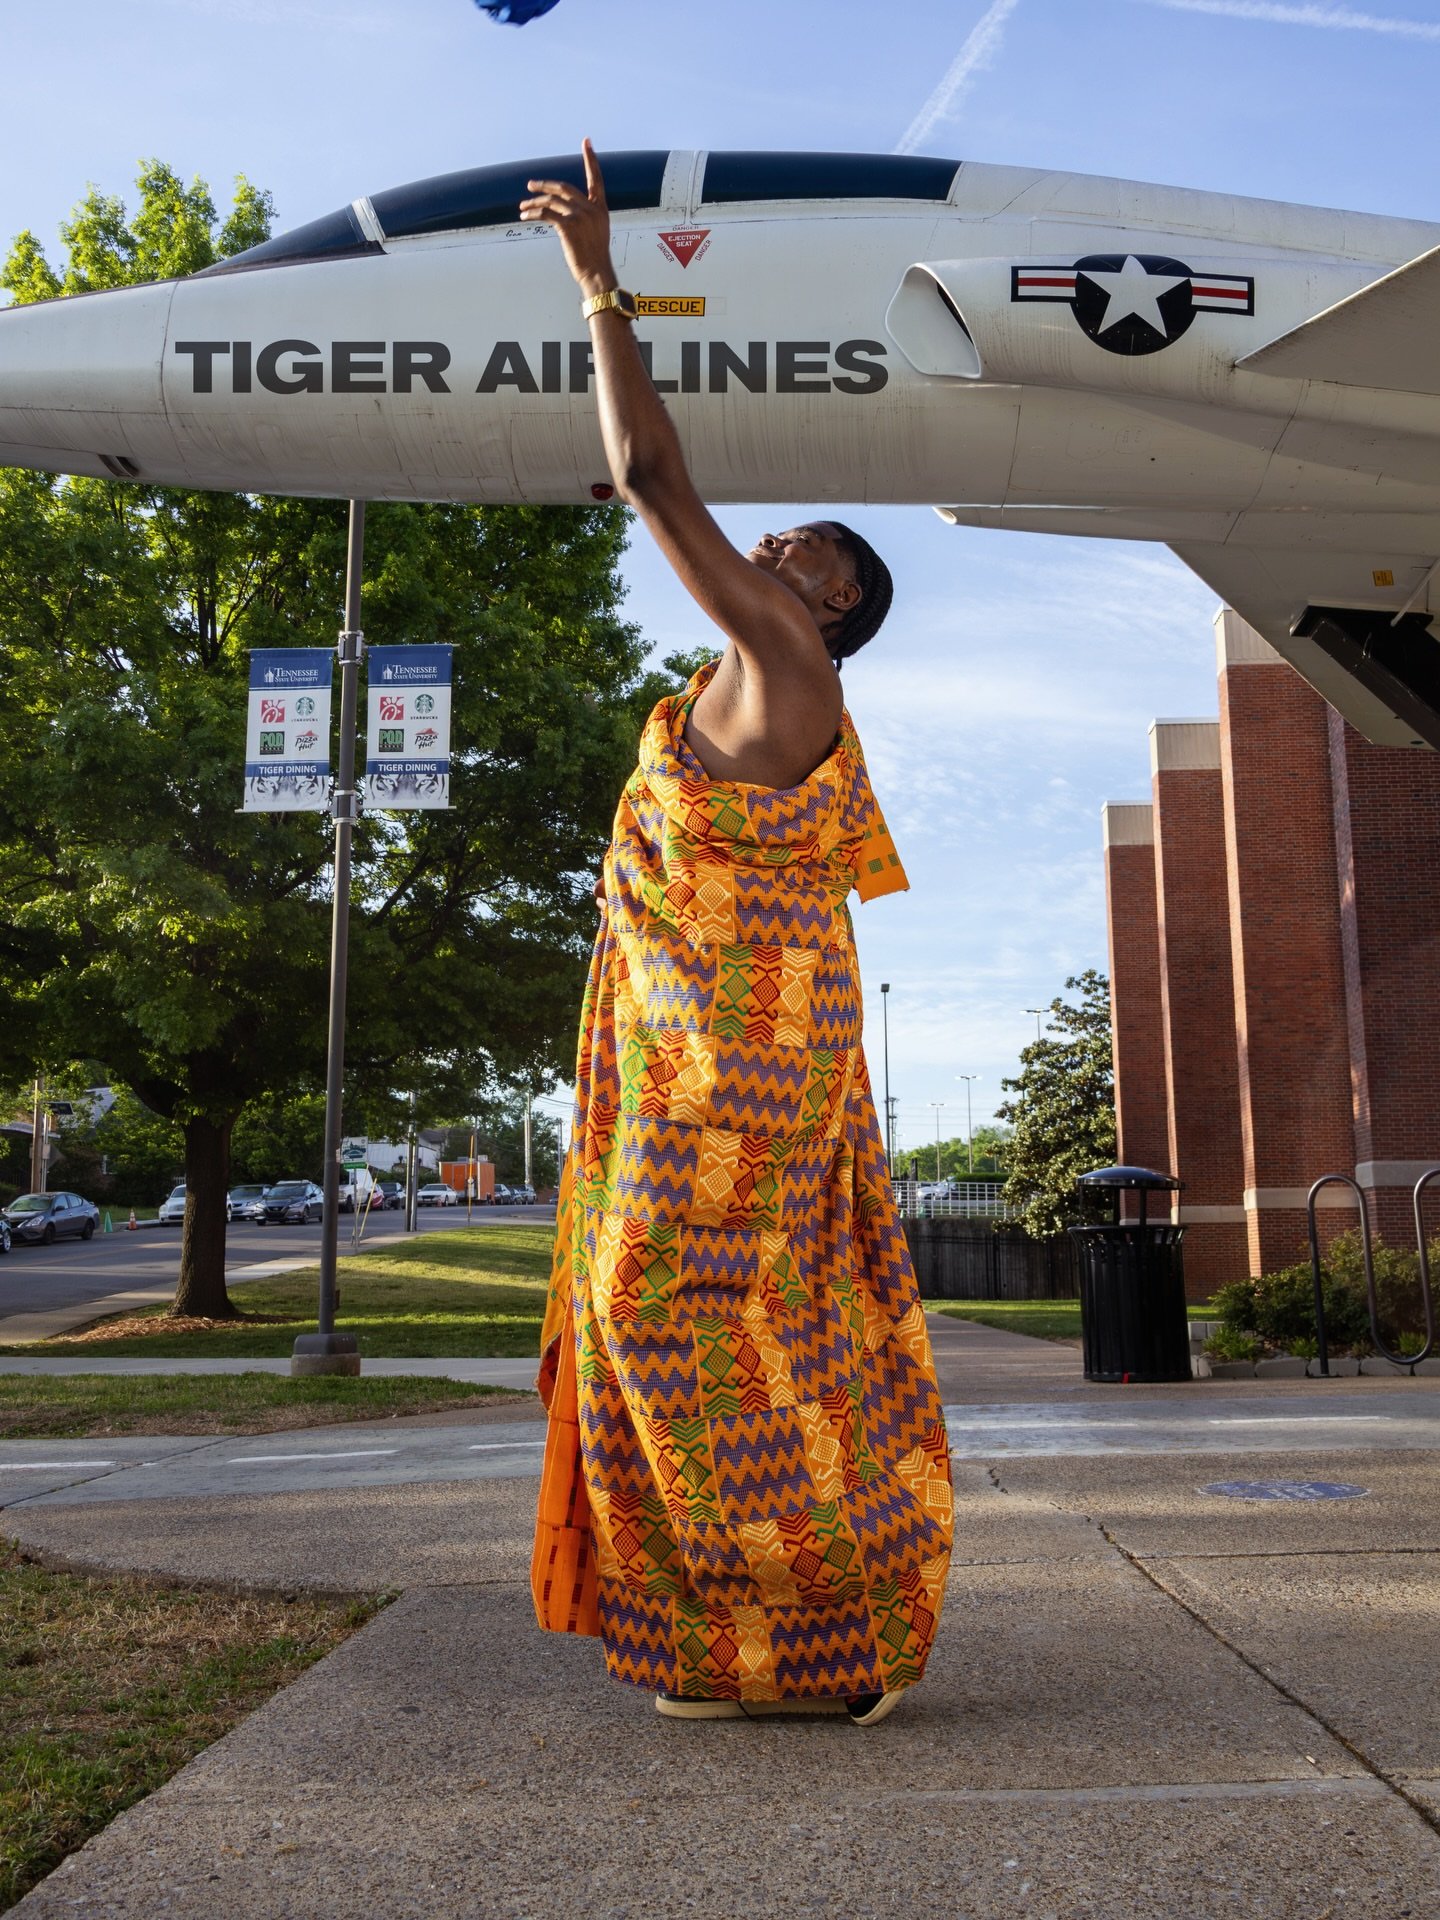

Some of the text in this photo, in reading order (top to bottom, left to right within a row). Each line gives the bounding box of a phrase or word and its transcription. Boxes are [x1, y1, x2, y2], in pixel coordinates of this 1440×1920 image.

[657, 242, 675, 263] DANGER
[695, 240, 711, 261] DANGER
[637, 301, 701, 313] RESCUE
[175, 339, 452, 395] TIGER
[274, 667, 319, 677] TENNESSEE
[392, 664, 438, 674] TENNESSEE
[415, 734, 438, 745] Pizza
[418, 741, 435, 749] Hut
[259, 765, 317, 774] TIGER DINING
[405, 763, 437, 771] DINING
